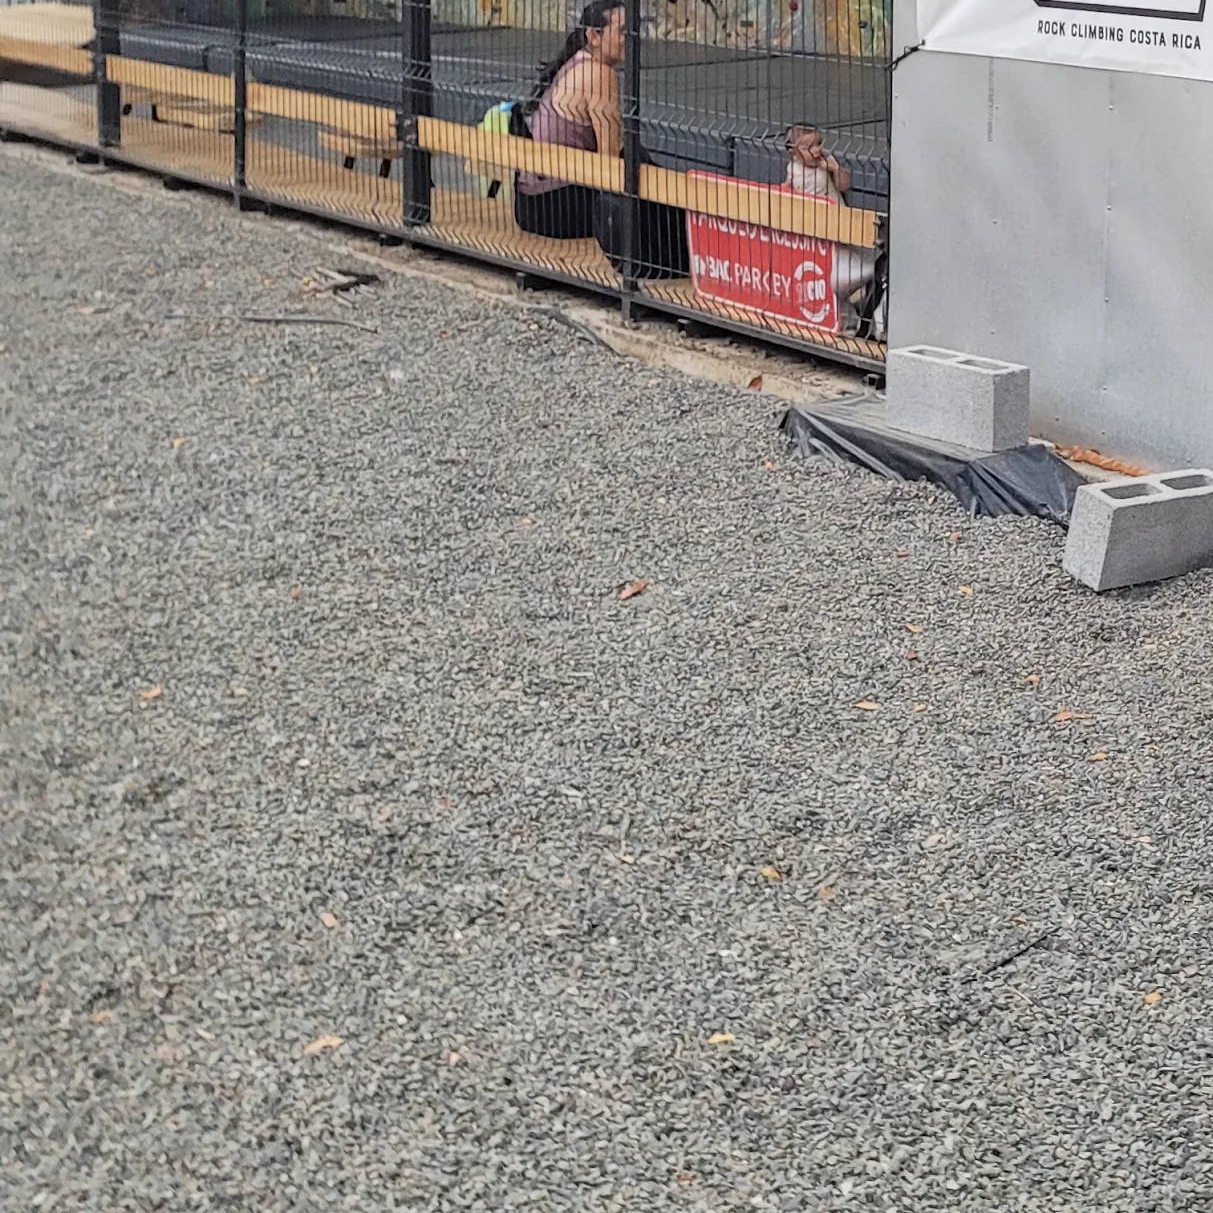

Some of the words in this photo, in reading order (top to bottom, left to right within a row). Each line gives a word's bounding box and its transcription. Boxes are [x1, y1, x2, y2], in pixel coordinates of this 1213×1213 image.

[1037, 19, 1066, 36] ROCK
[1071, 23, 1124, 42] CLIMBING
[1130, 29, 1166, 47] COSTA
[1172, 33, 1202, 51] RICA
